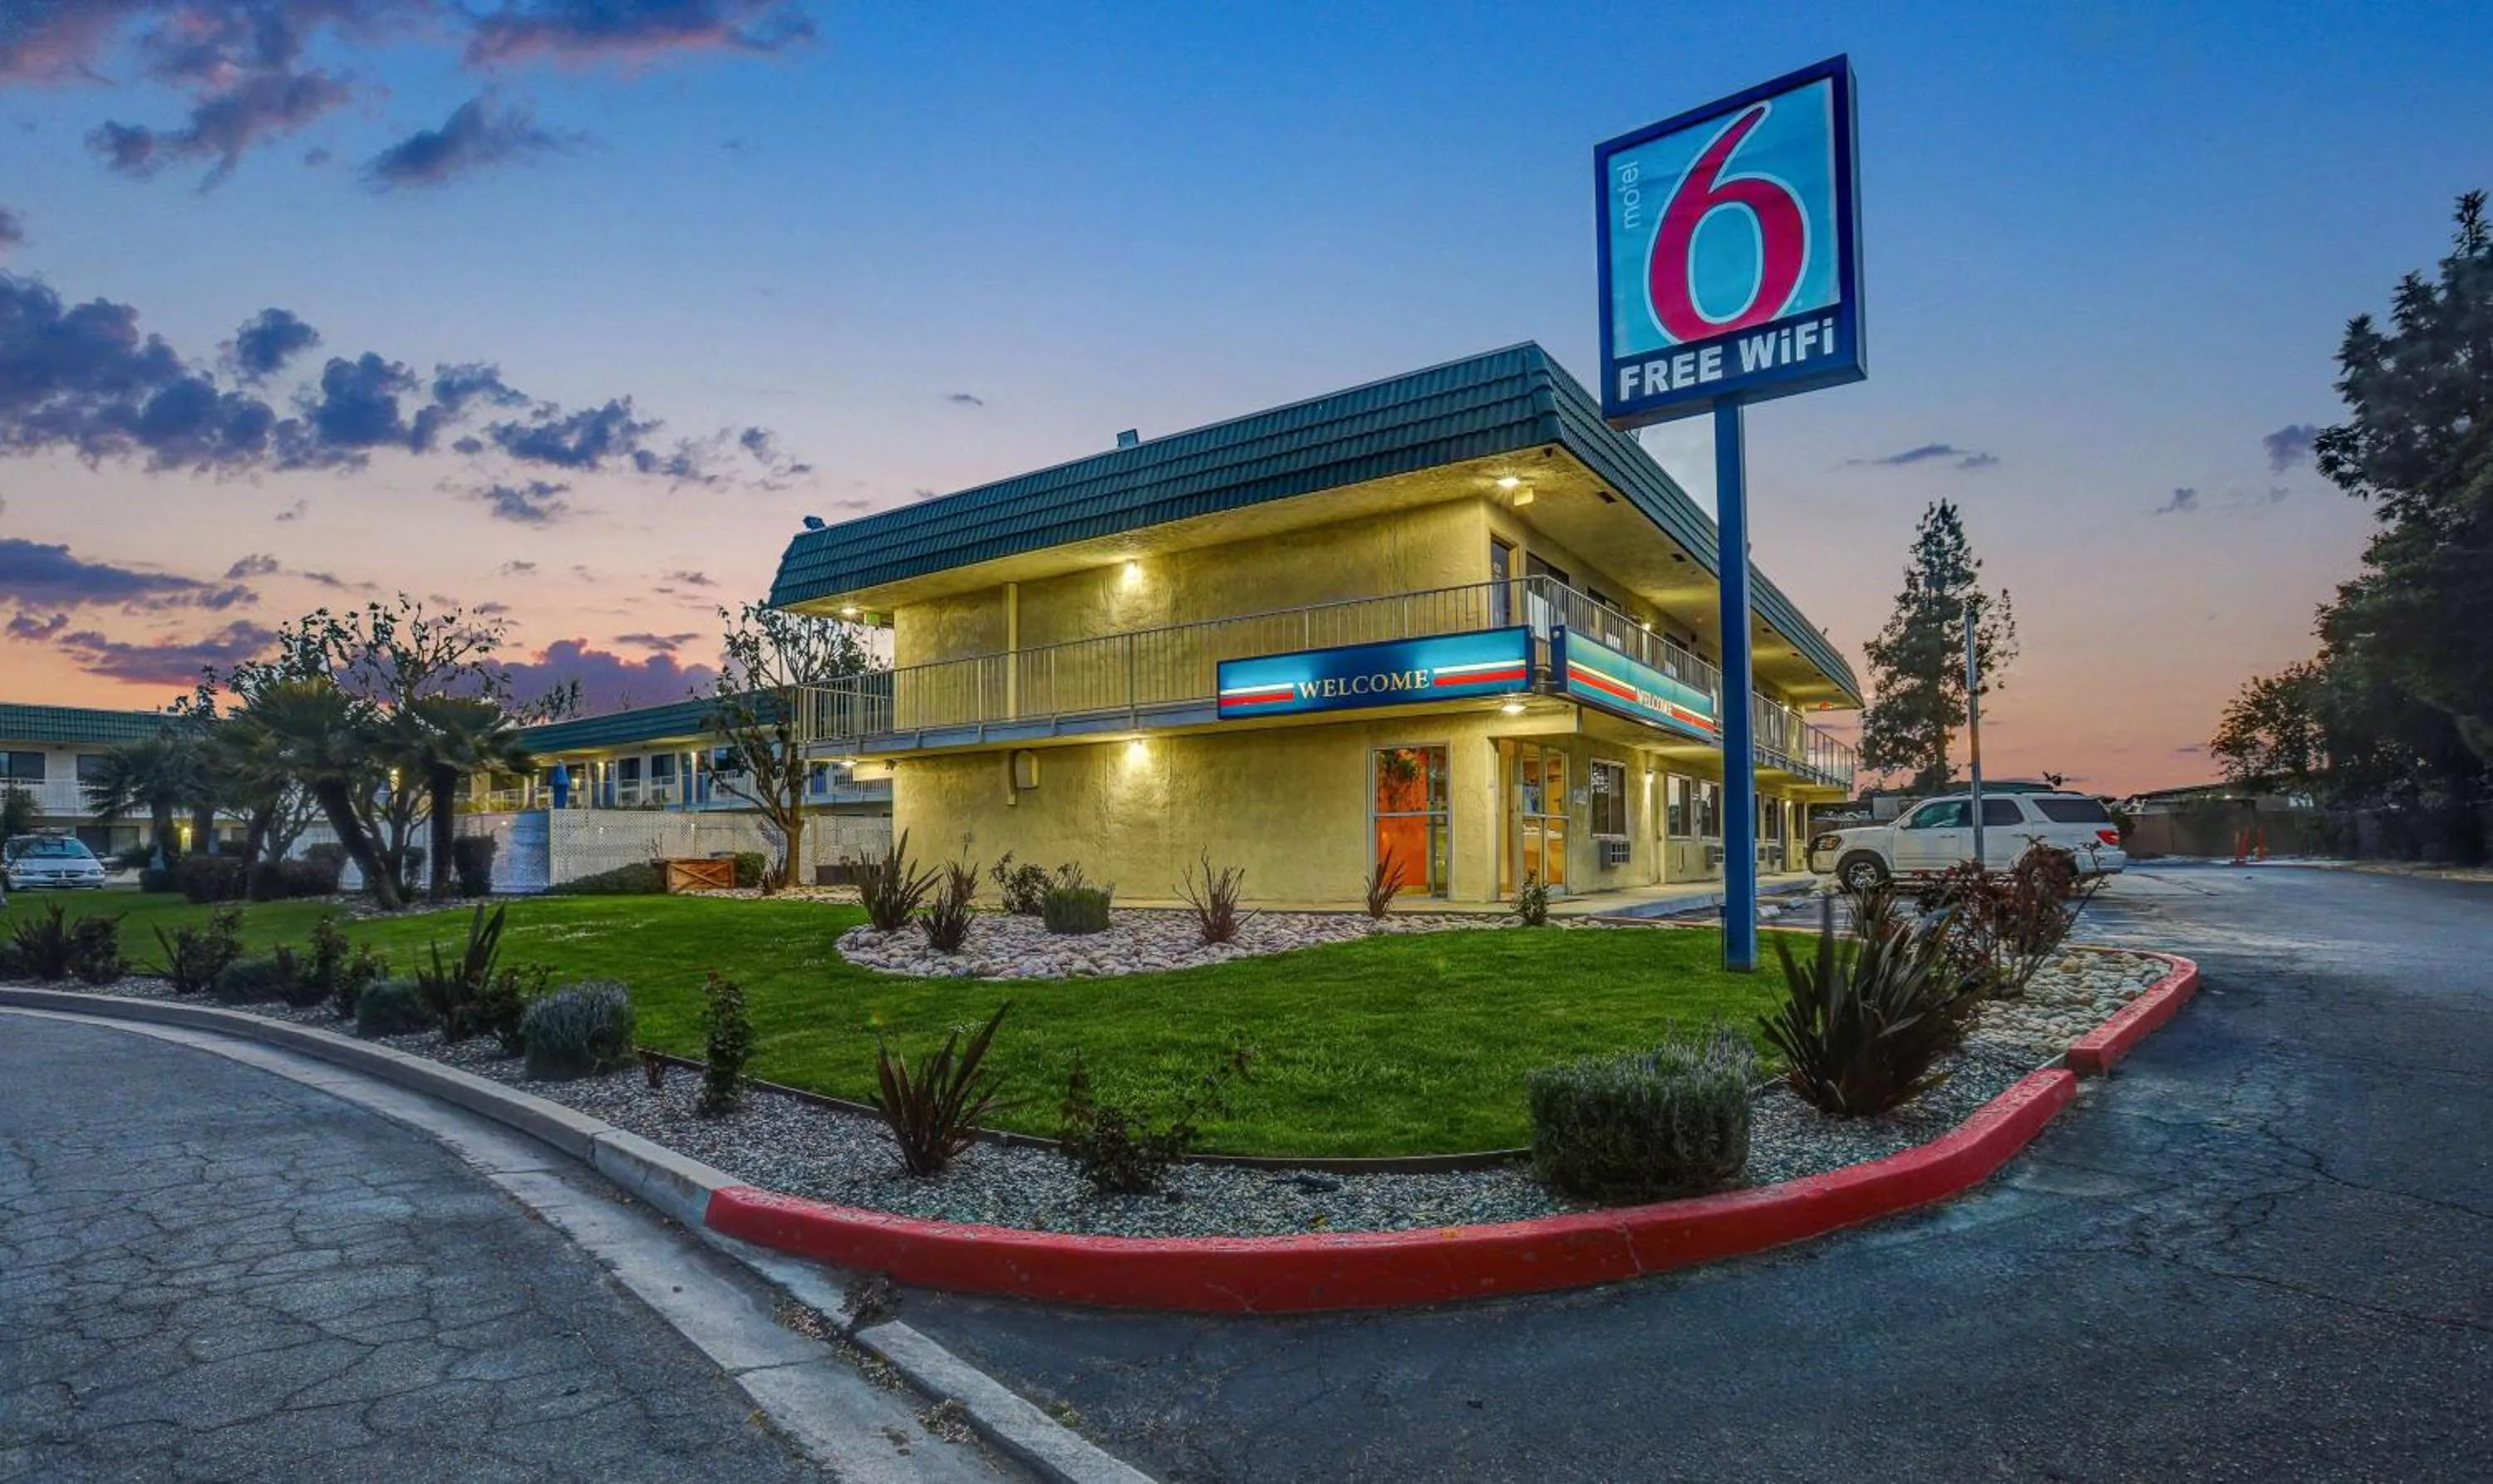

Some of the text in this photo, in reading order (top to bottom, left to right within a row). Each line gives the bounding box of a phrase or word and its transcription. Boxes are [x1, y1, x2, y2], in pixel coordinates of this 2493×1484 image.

[1617, 101, 1811, 344] motel 6
[1619, 317, 1834, 401] FREE WiFi
[1298, 669, 1430, 699] WELCOME
[1635, 686, 1674, 716] WELCOME
